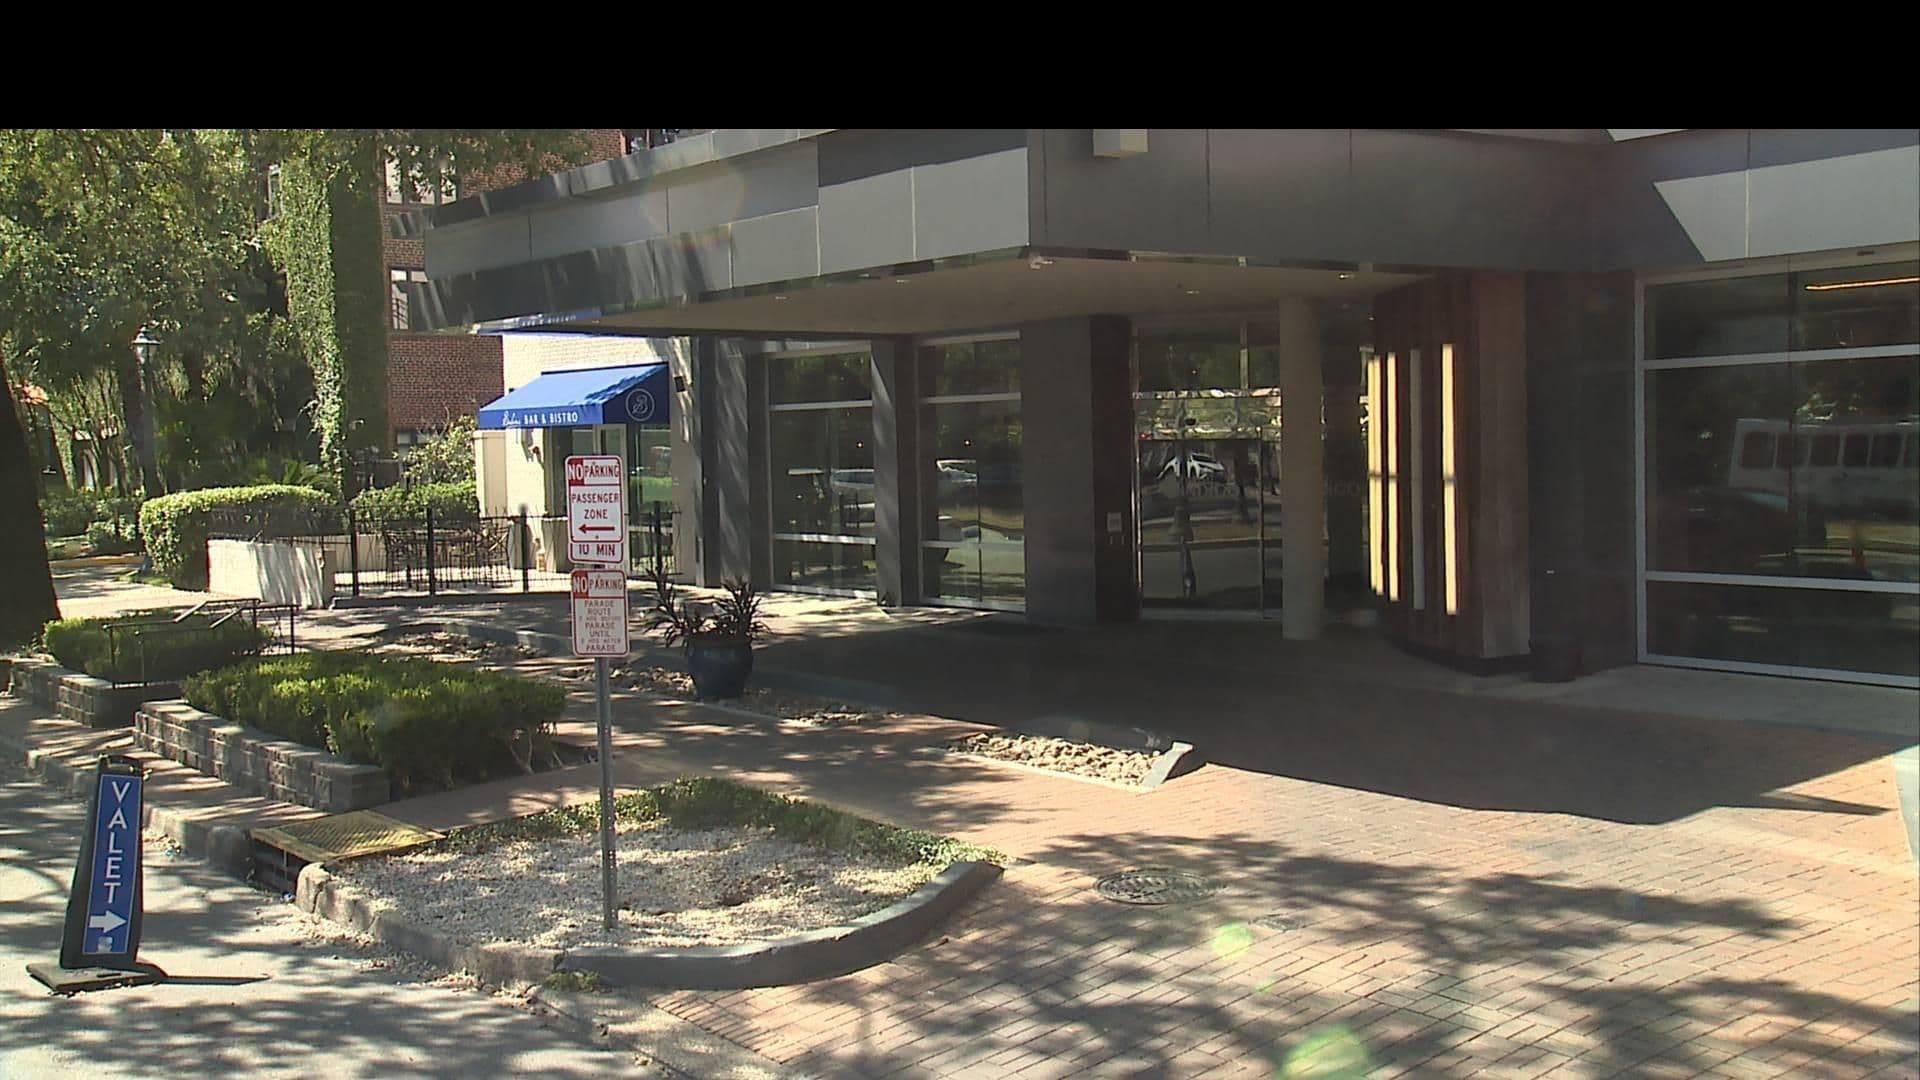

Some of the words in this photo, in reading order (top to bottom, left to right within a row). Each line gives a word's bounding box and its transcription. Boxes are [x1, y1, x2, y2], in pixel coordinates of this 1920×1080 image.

[524, 413, 538, 425] BAR
[549, 411, 579, 424] BISTRO
[568, 463, 584, 480] NO
[584, 465, 619, 478] PARKING
[572, 493, 619, 503] PASSENGER
[584, 509, 608, 519] ZONE
[596, 545, 616, 557] MIN
[573, 577, 588, 593] NO
[589, 579, 623, 591] PARKING
[584, 600, 615, 608] PARADE
[587, 608, 612, 616] ROUTE
[585, 622, 616, 630] PARADE
[586, 644, 617, 653] PARADE
[103, 781, 131, 904] VALET
